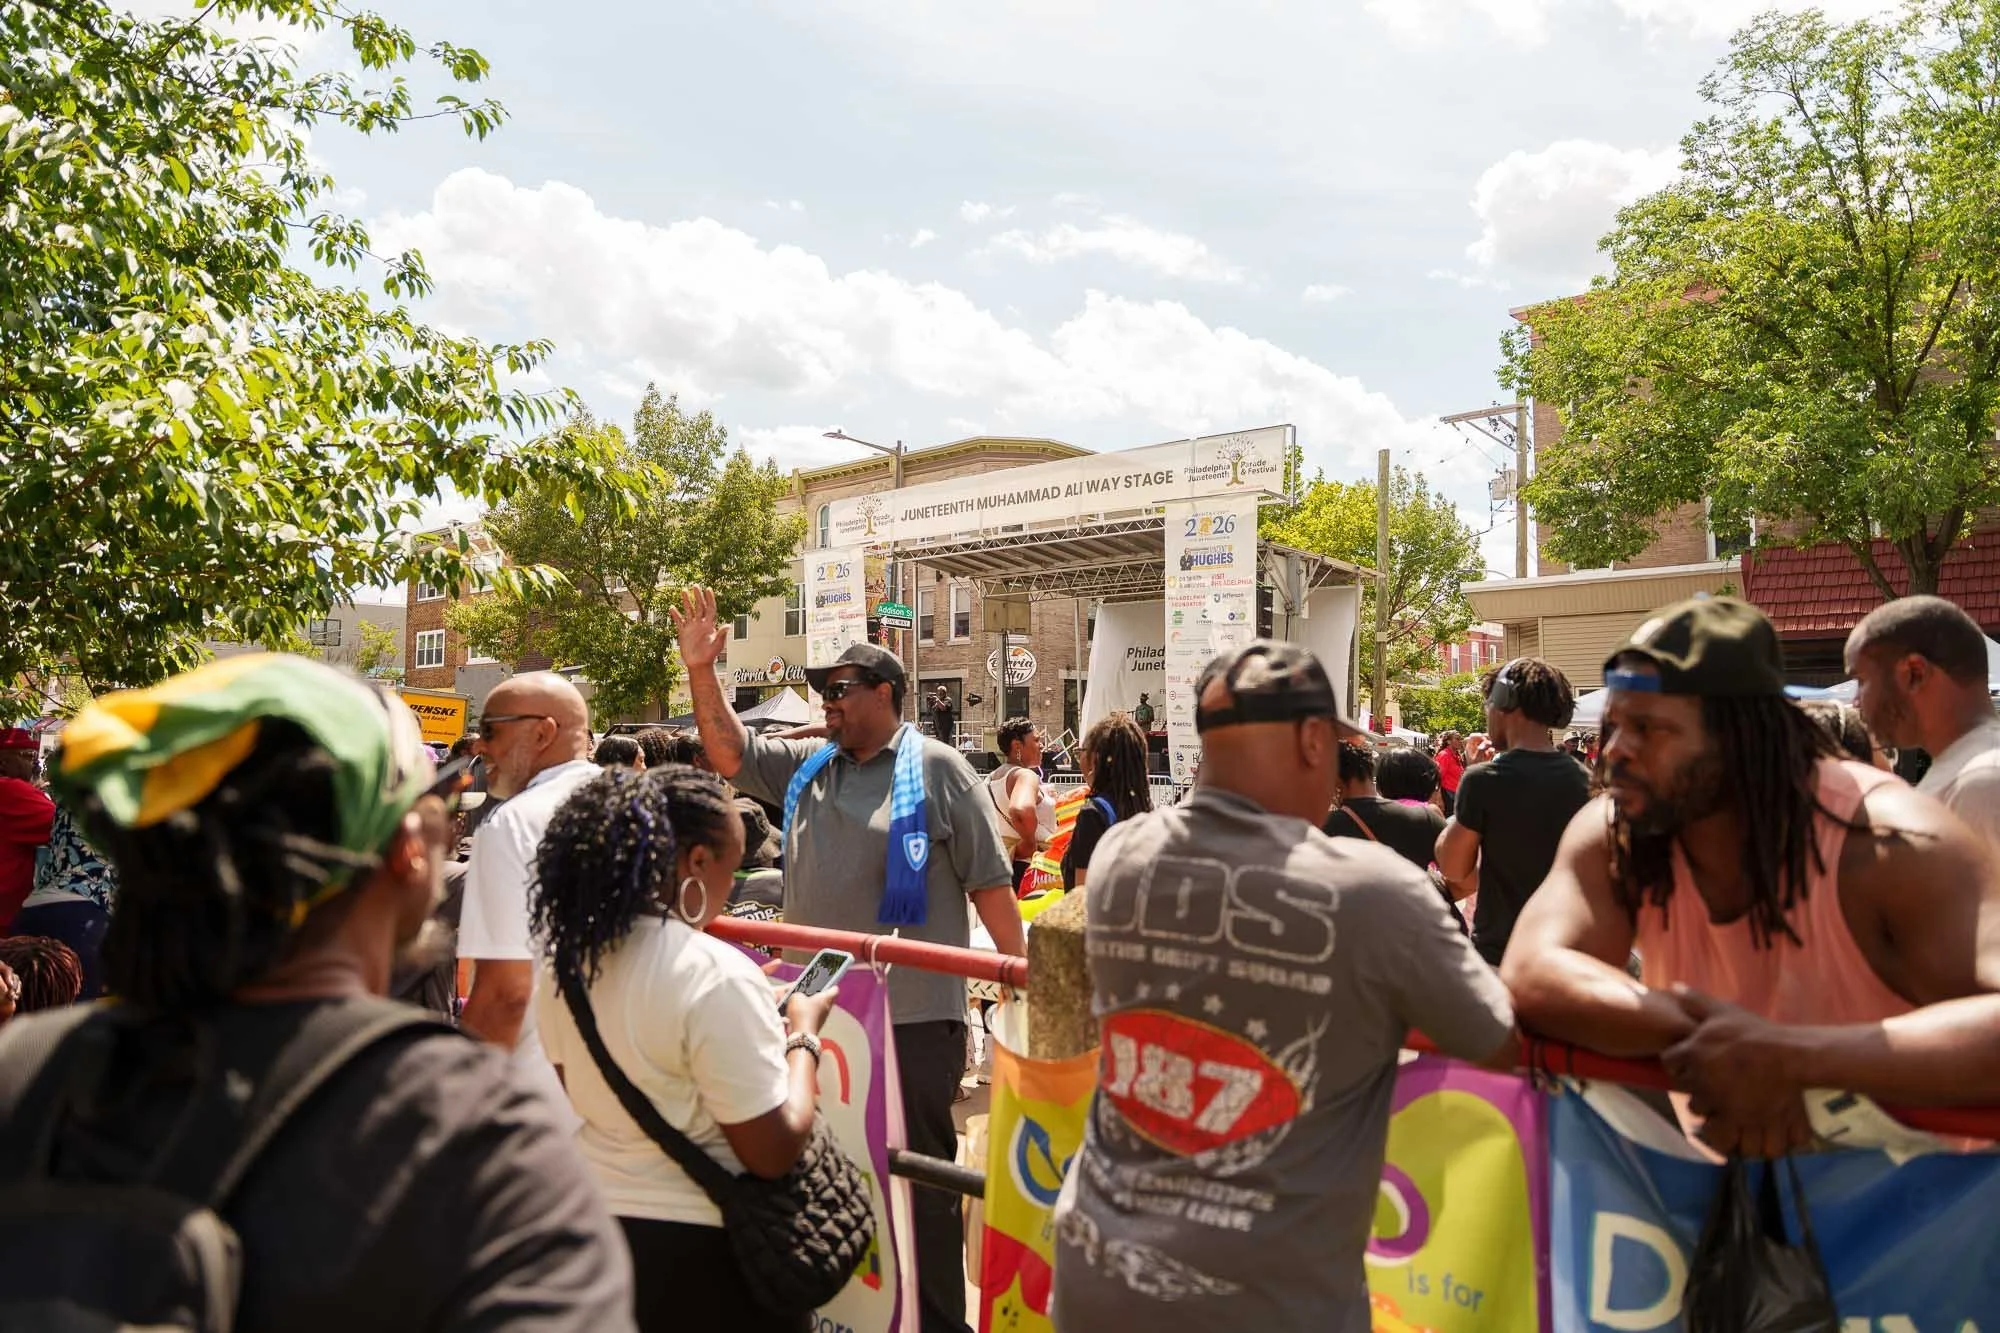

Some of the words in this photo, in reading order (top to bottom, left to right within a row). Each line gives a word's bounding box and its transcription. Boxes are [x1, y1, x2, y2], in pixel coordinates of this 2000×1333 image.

[1184, 463, 1230, 475] Philadelphia
[1240, 459, 1267, 468] Parade
[1247, 464, 1277, 474] Festival
[1188, 470, 1230, 482] Juneteenth
[900, 498, 974, 521] JUNETEENTH
[976, 485, 1061, 510] MUHAMMAD
[1086, 476, 1121, 494] WAY
[1123, 470, 1174, 489] STAGE
[835, 517, 867, 528] Philadelphia
[840, 524, 867, 534] Juneteenth
[1191, 551, 1234, 566] HUGHES
[1211, 578, 1254, 587] PHILADELPHIA
[823, 592, 852, 605] HUGHES
[878, 605, 905, 617] Addison
[906, 609, 913, 617] St
[1126, 646, 1165, 659] Philad
[1131, 660, 1165, 672] Junet
[734, 668, 767, 683] Birria
[410, 704, 458, 716] PENSKE
[1406, 1262, 1431, 1296] is
[1442, 1270, 1485, 1314] for
